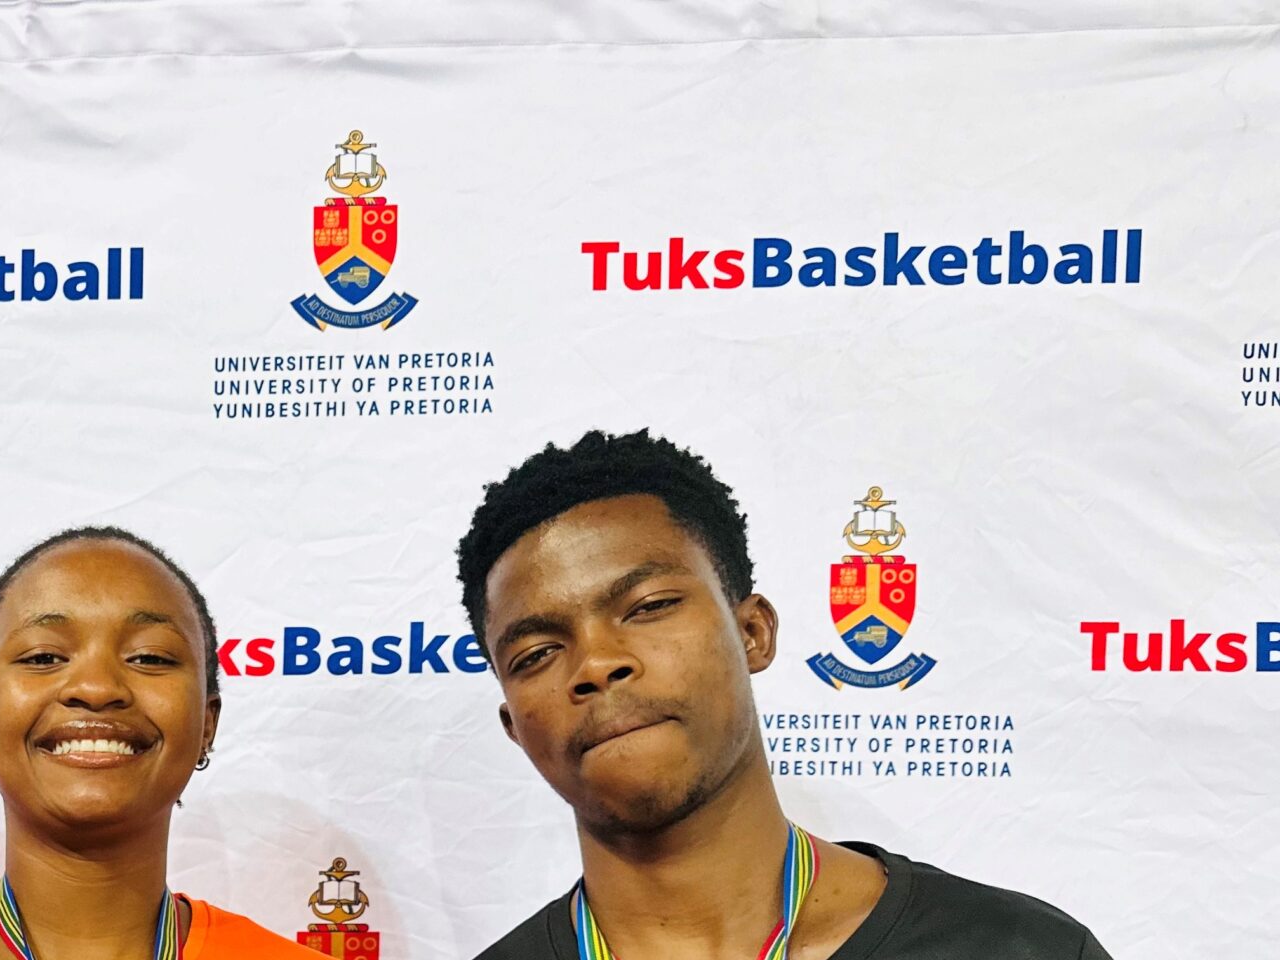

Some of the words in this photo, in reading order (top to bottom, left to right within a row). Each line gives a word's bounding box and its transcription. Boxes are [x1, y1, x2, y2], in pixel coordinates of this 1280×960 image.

[581, 229, 1142, 291] TuksBasketball
[318, 306, 360, 326] DESTINATUM
[215, 355, 345, 373] UNIVERSITEIT
[354, 354, 389, 370] VAN
[398, 352, 494, 369] PRETORIA
[214, 378, 342, 396] UNIVERSITY
[352, 377, 376, 393] OF
[388, 375, 494, 393] PRETORIA
[213, 401, 346, 419] YUNIBESITHI
[356, 401, 380, 416] YA
[390, 398, 493, 416] PRETORIA
[870, 715, 907, 730] VAN
[916, 715, 1014, 730] PRETORIA
[869, 738, 893, 753] OF
[906, 738, 1013, 754] PRETORIA
[873, 761, 896, 776] YA
[907, 762, 1012, 777] PRETORIA
